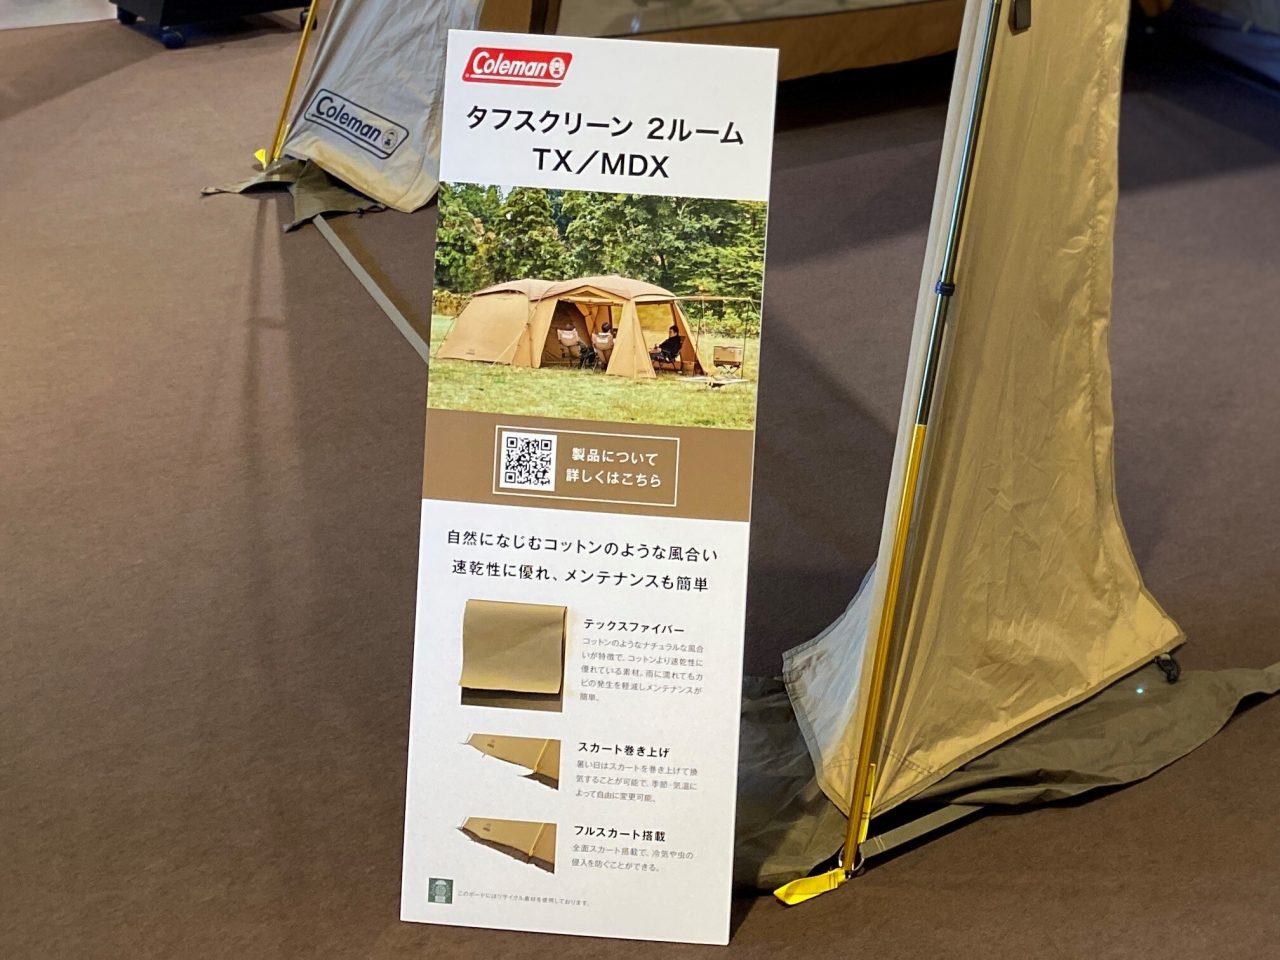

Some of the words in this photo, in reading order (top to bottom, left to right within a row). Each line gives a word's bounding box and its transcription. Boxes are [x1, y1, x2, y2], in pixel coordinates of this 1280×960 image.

[473, 51, 548, 77] Coleman
[316, 96, 382, 142] Coleman
[466, 105, 633, 137] タフスクリーン
[647, 117, 744, 145] 2ルーム
[572, 447, 659, 467] 製品について
[565, 468, 662, 488] 詳しくはこちら
[447, 529, 718, 563] 自然になじむコットンのような風合い
[452, 559, 709, 592] 速乾性に優れ、メンテナンスも簡単
[584, 618, 685, 635] テックスファイバー
[583, 637, 704, 653] コットンのようなナチュラルな風合
[578, 742, 670, 758] スカート巻き上げ
[576, 759, 698, 776] 暑い日はスカートを巻き上げて換
[575, 789, 656, 803] よって自由に変更可能。
[574, 825, 666, 842] フルスカート搭載
